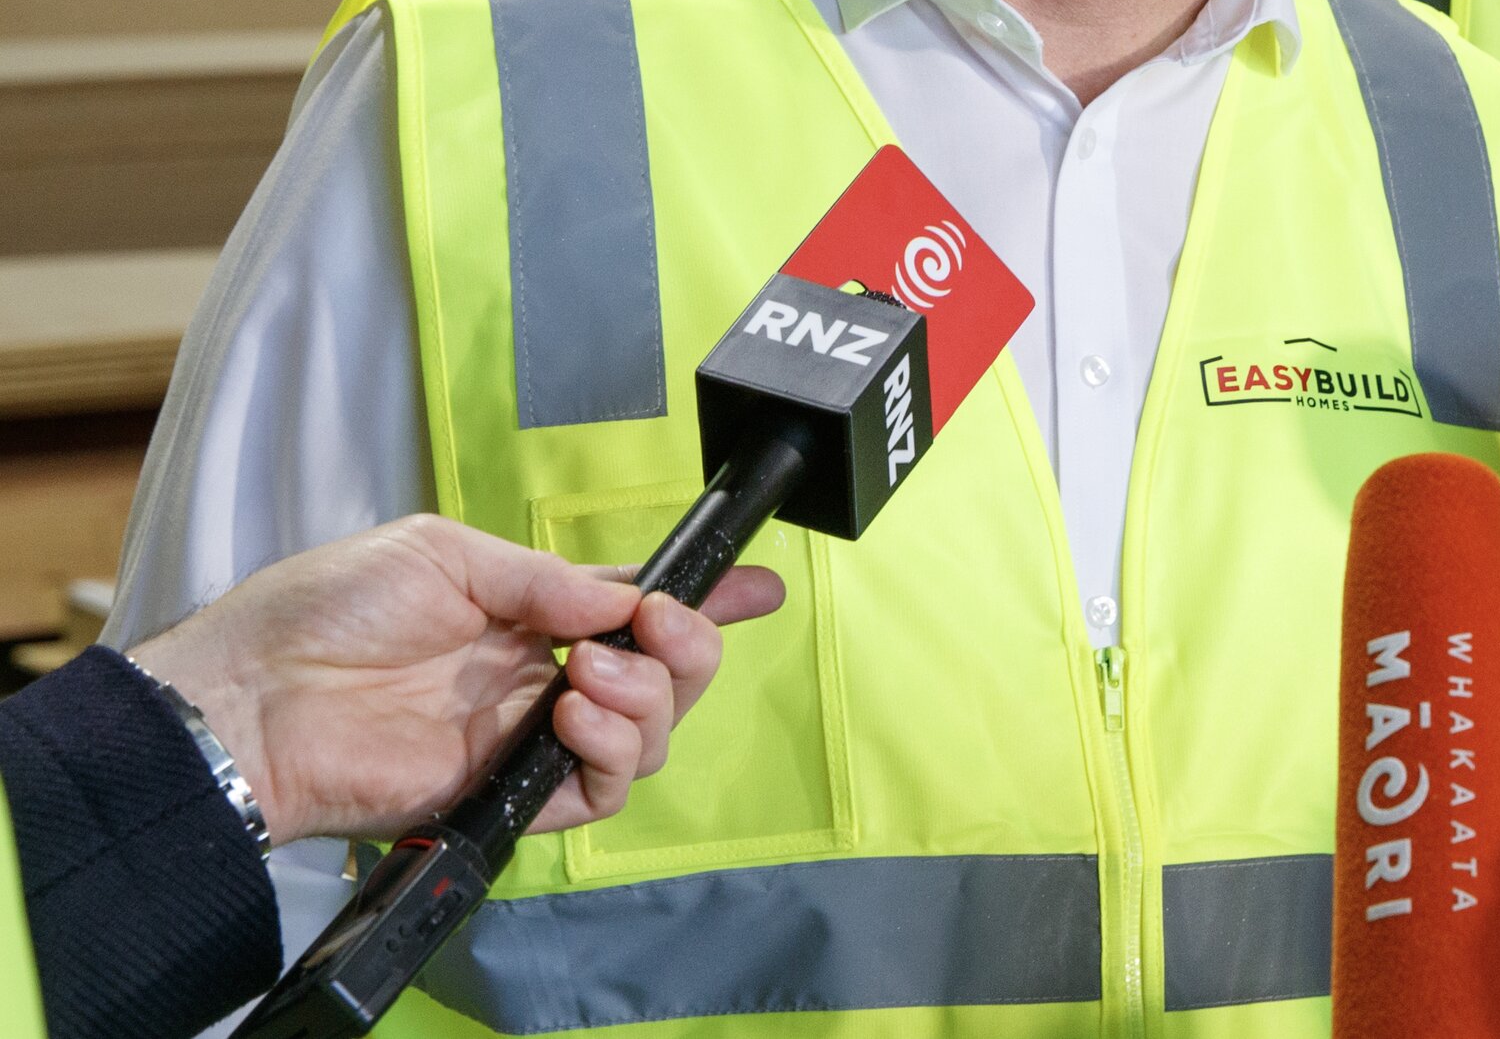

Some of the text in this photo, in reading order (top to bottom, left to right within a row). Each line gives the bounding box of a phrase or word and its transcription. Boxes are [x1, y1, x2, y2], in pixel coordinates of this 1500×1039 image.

[743, 299, 890, 366] RNZ
[1216, 364, 1410, 403] EASYBUILD
[1296, 395, 1350, 412] HOMES
[884, 352, 916, 489] RNZ
[1447, 632, 1479, 913] WHAKAATA
